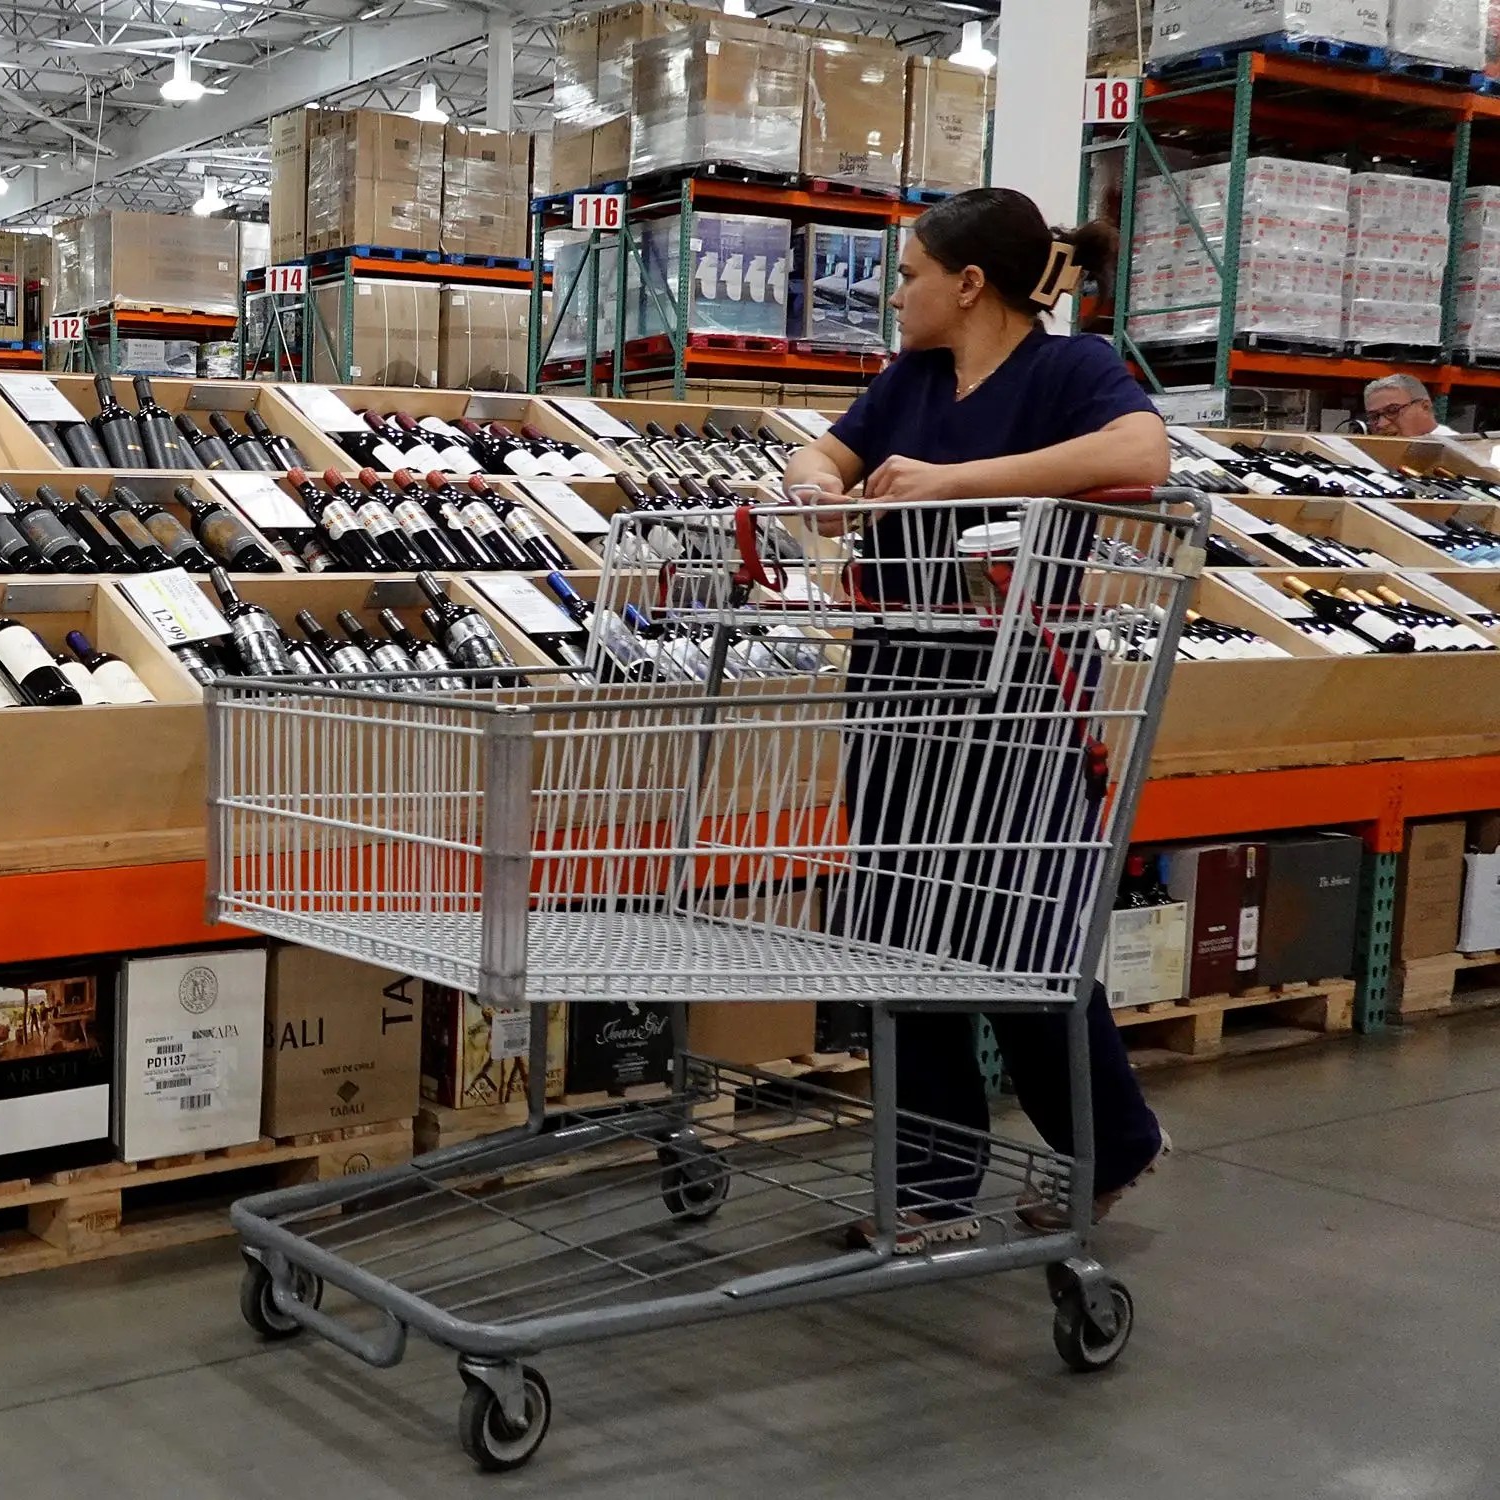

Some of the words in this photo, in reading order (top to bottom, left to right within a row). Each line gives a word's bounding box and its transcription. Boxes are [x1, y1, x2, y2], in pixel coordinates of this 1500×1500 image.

[1160, 23, 1180, 36] LED
[579, 197, 618, 227] 116
[269, 269, 302, 292] 114
[52, 319, 79, 338] 112
[152, 608, 187, 641] 12.99
